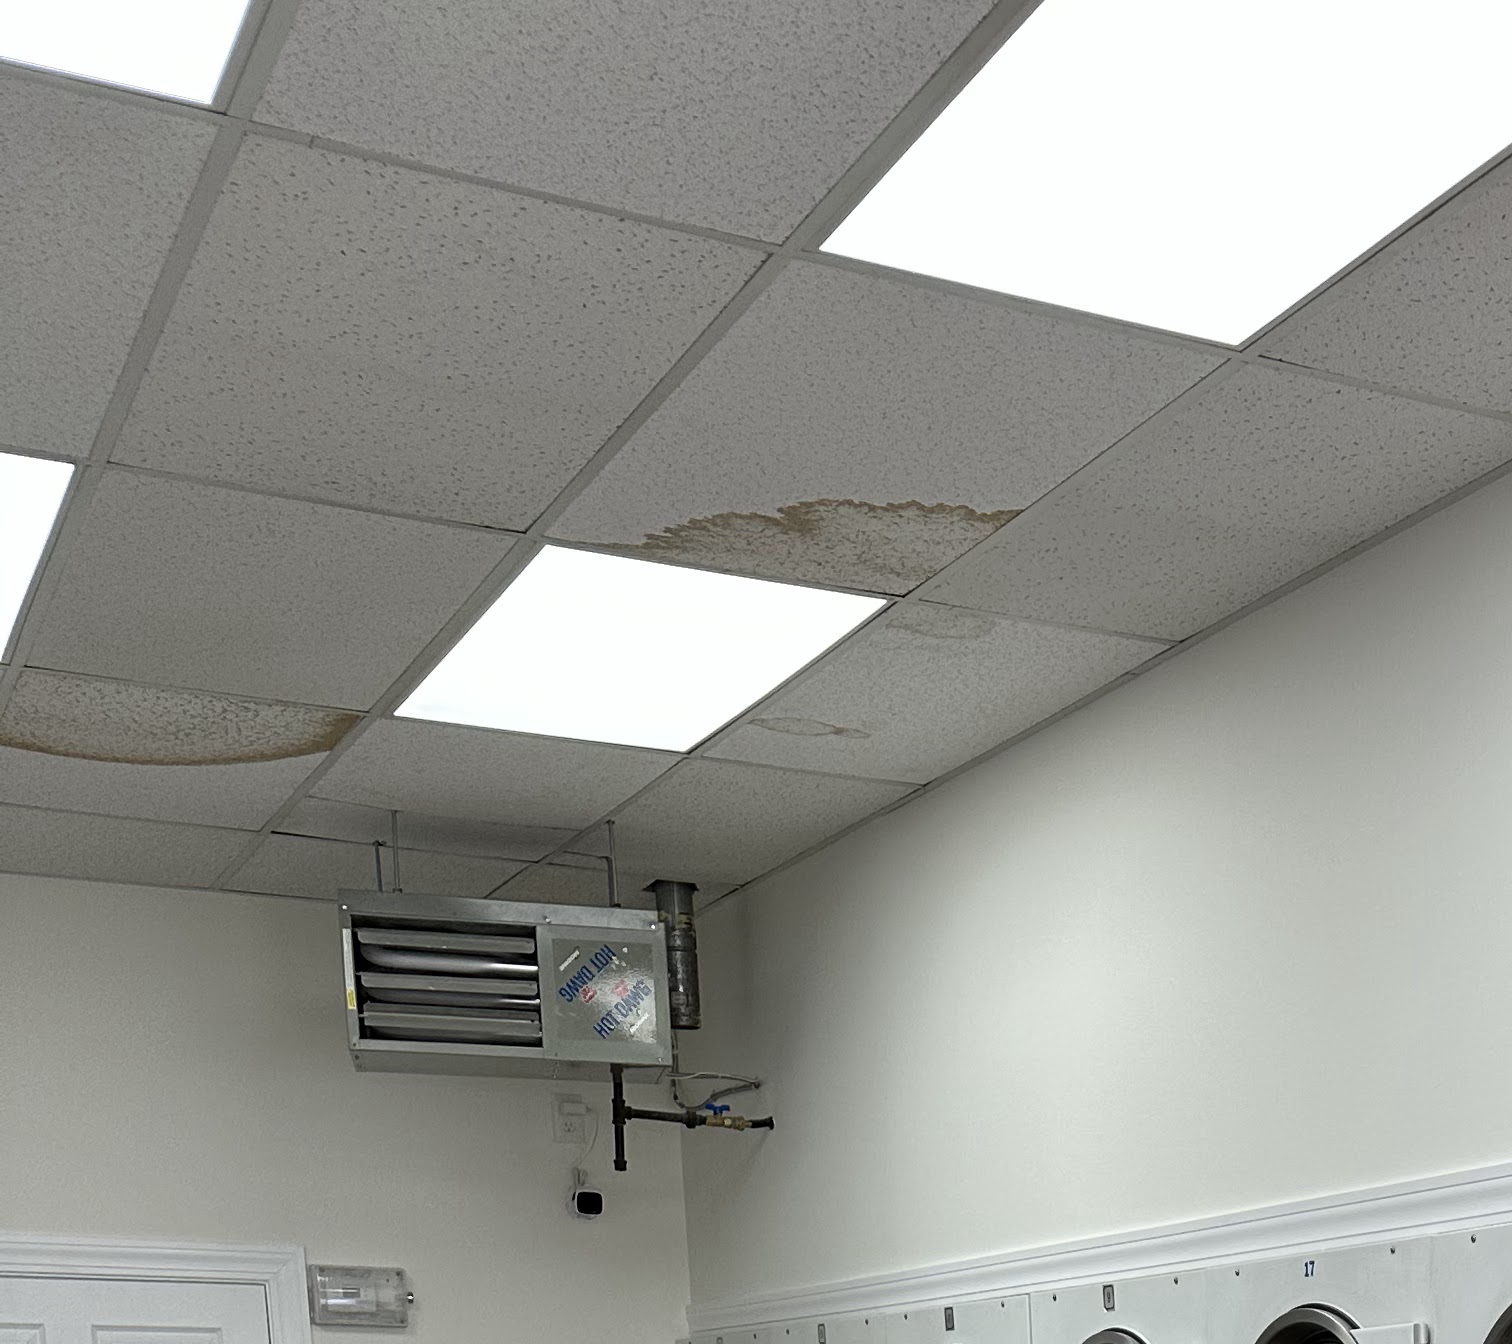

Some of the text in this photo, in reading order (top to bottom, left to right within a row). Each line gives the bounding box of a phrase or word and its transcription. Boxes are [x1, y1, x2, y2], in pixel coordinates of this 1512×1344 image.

[590, 944, 617, 974] HOT
[558, 965, 596, 1003] DAWG
[593, 1010, 620, 1039] HOT
[1304, 1261, 1315, 1278] 17
